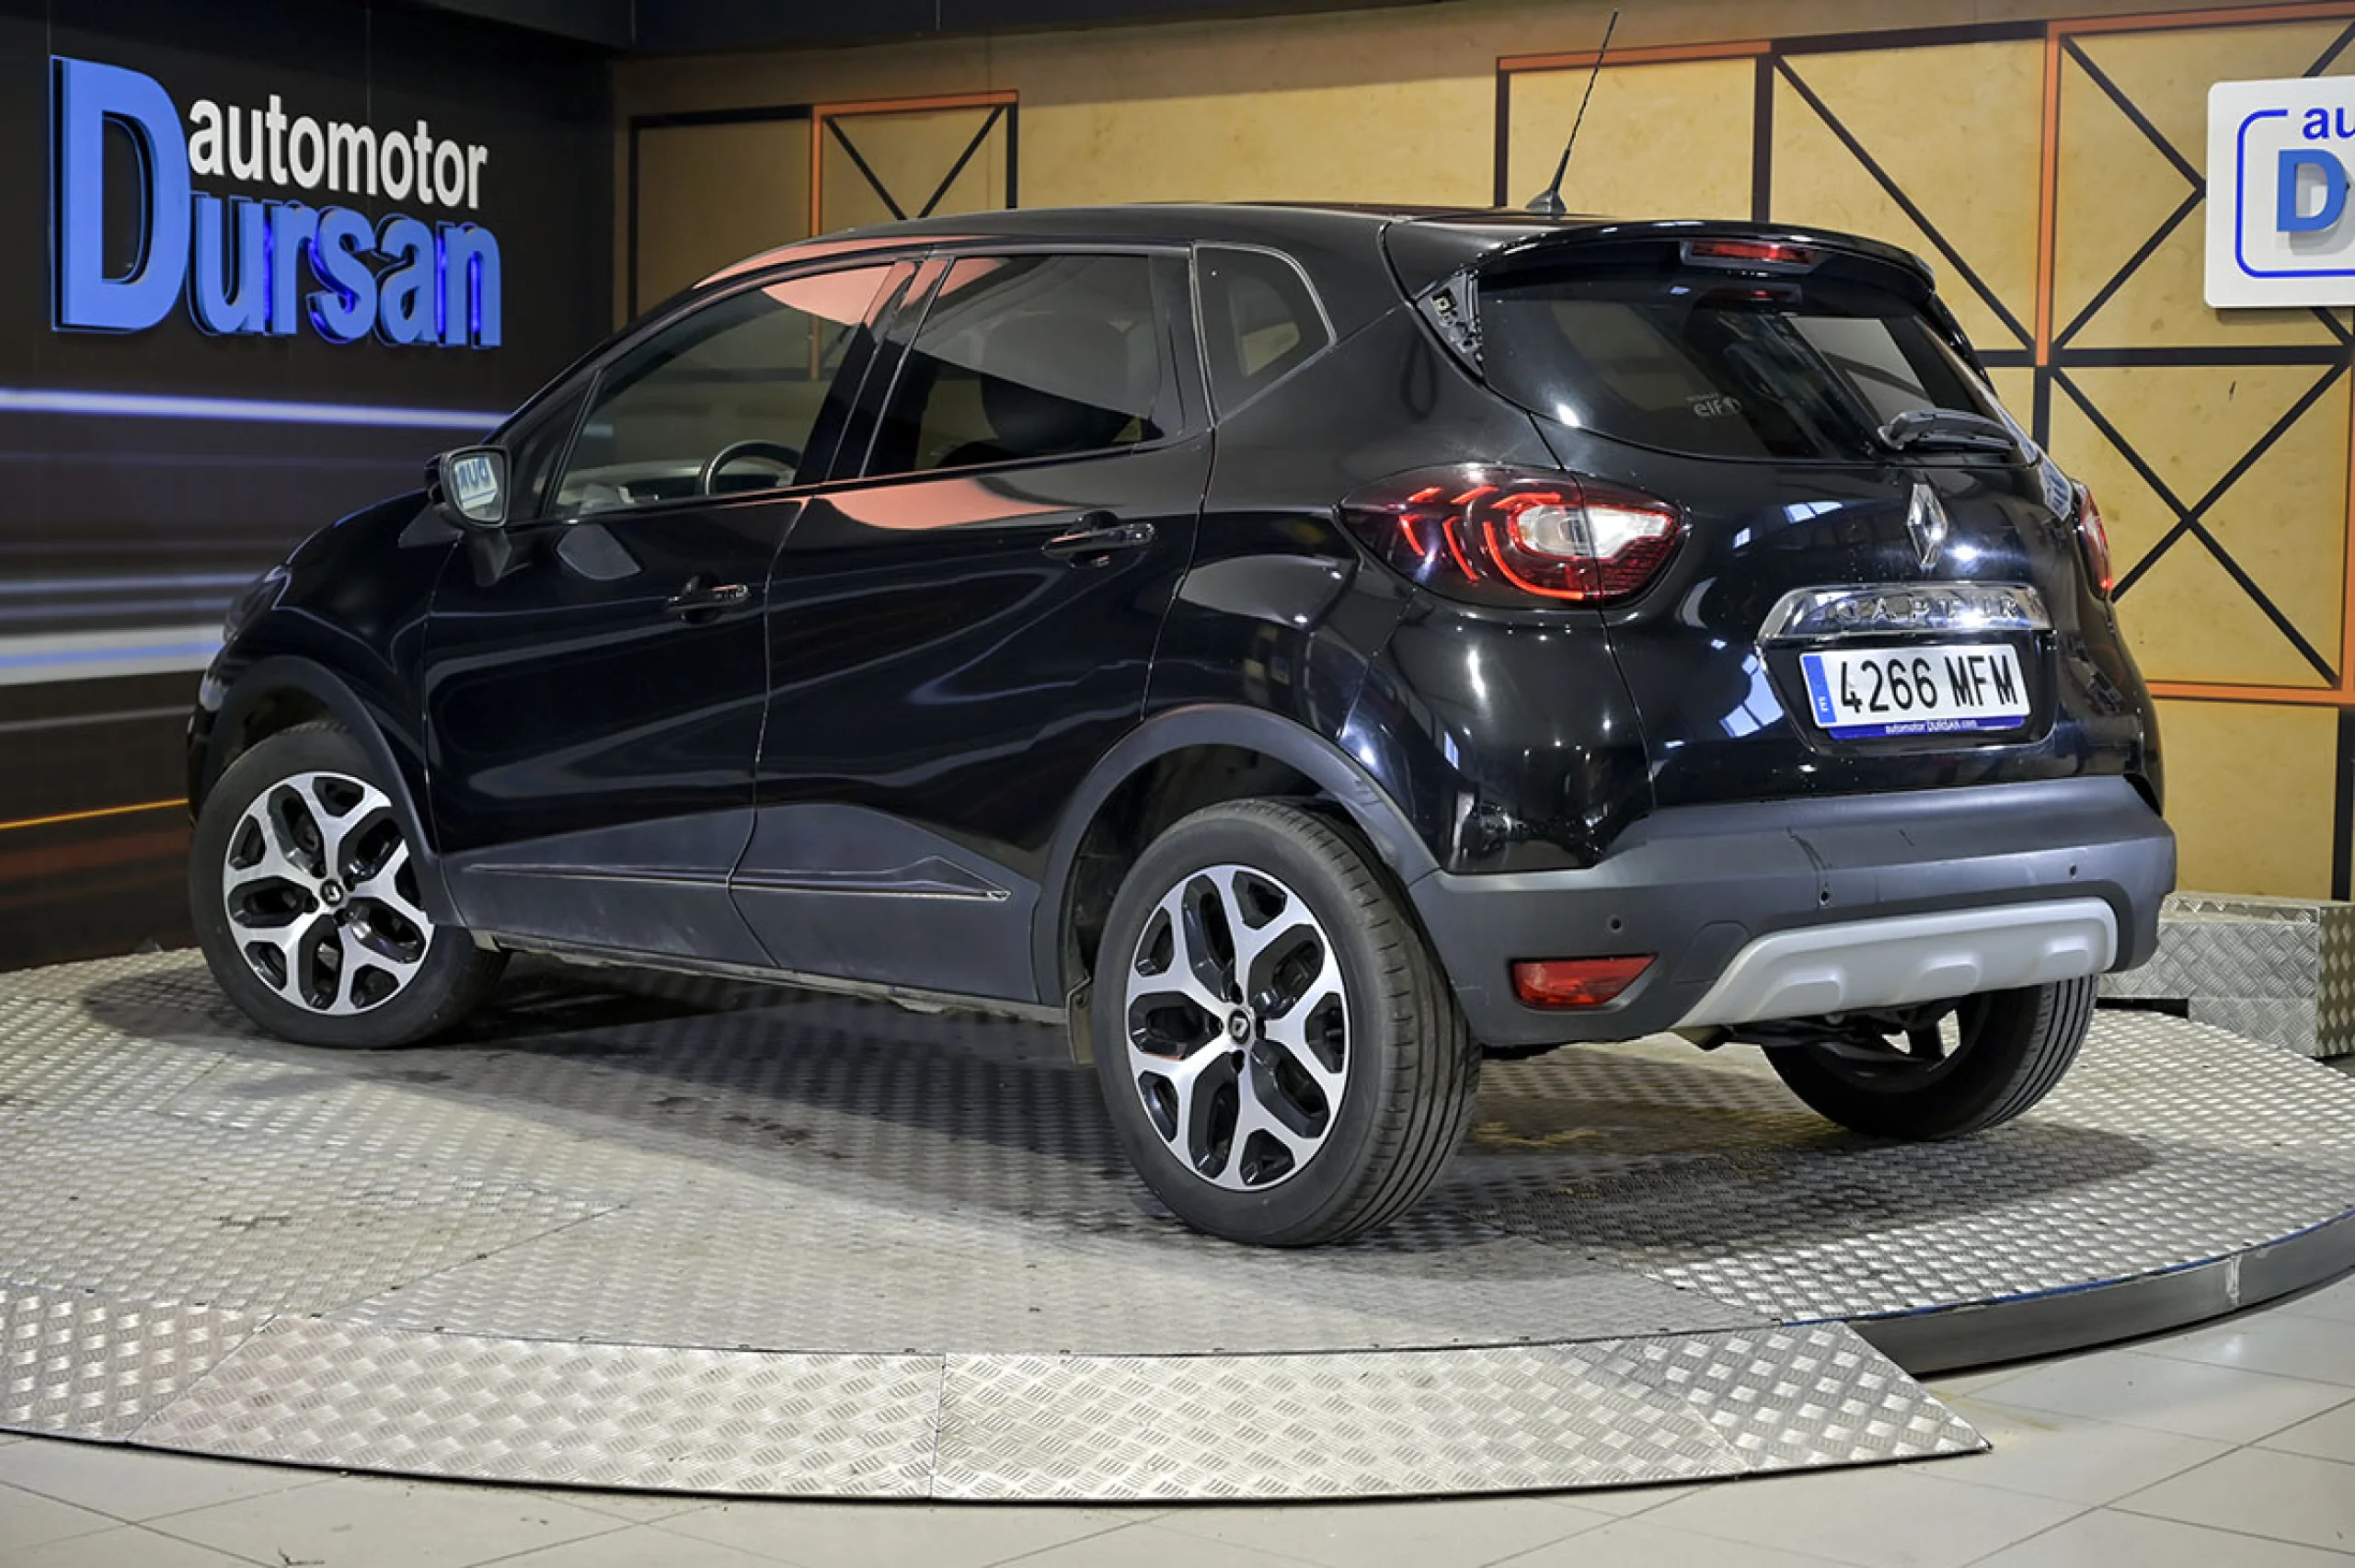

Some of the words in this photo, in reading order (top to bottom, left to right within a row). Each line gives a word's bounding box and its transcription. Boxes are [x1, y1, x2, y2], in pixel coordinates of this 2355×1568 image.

[51, 54, 501, 349] Dursan
[188, 95, 487, 208] automotor
[1841, 657, 1938, 714] 4266
[1944, 655, 2018, 707] MFM
